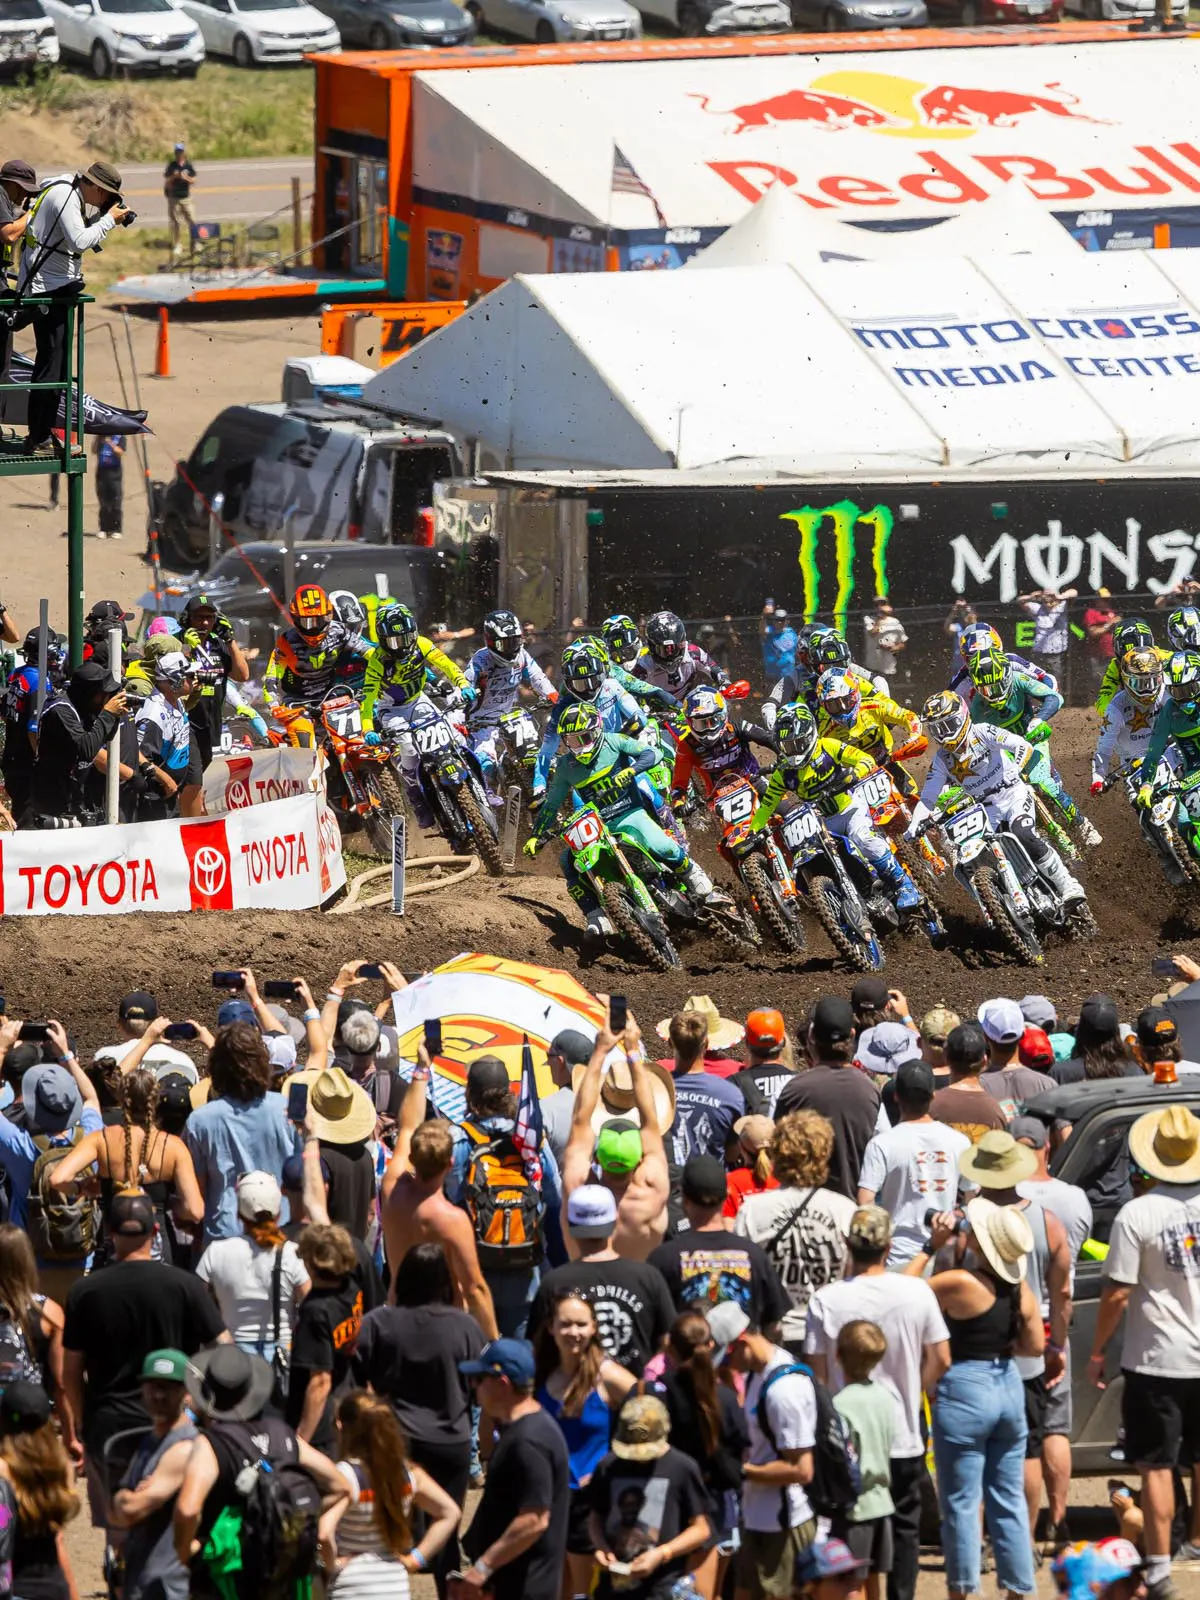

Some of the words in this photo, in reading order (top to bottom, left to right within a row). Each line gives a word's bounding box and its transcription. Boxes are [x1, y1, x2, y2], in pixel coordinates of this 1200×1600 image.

[706, 150, 990, 208] Red
[894, 360, 1057, 387] MEDIA
[332, 708, 363, 739] 71
[416, 719, 450, 753] 226
[508, 718, 539, 746] 74
[719, 790, 753, 823] 13
[568, 815, 600, 850] 10
[784, 810, 819, 848] 180
[953, 810, 984, 844] 59
[240, 831, 310, 887] TOYOTA
[18, 858, 159, 910] TOYOTA
[688, 1092, 722, 1108] OCEAN
